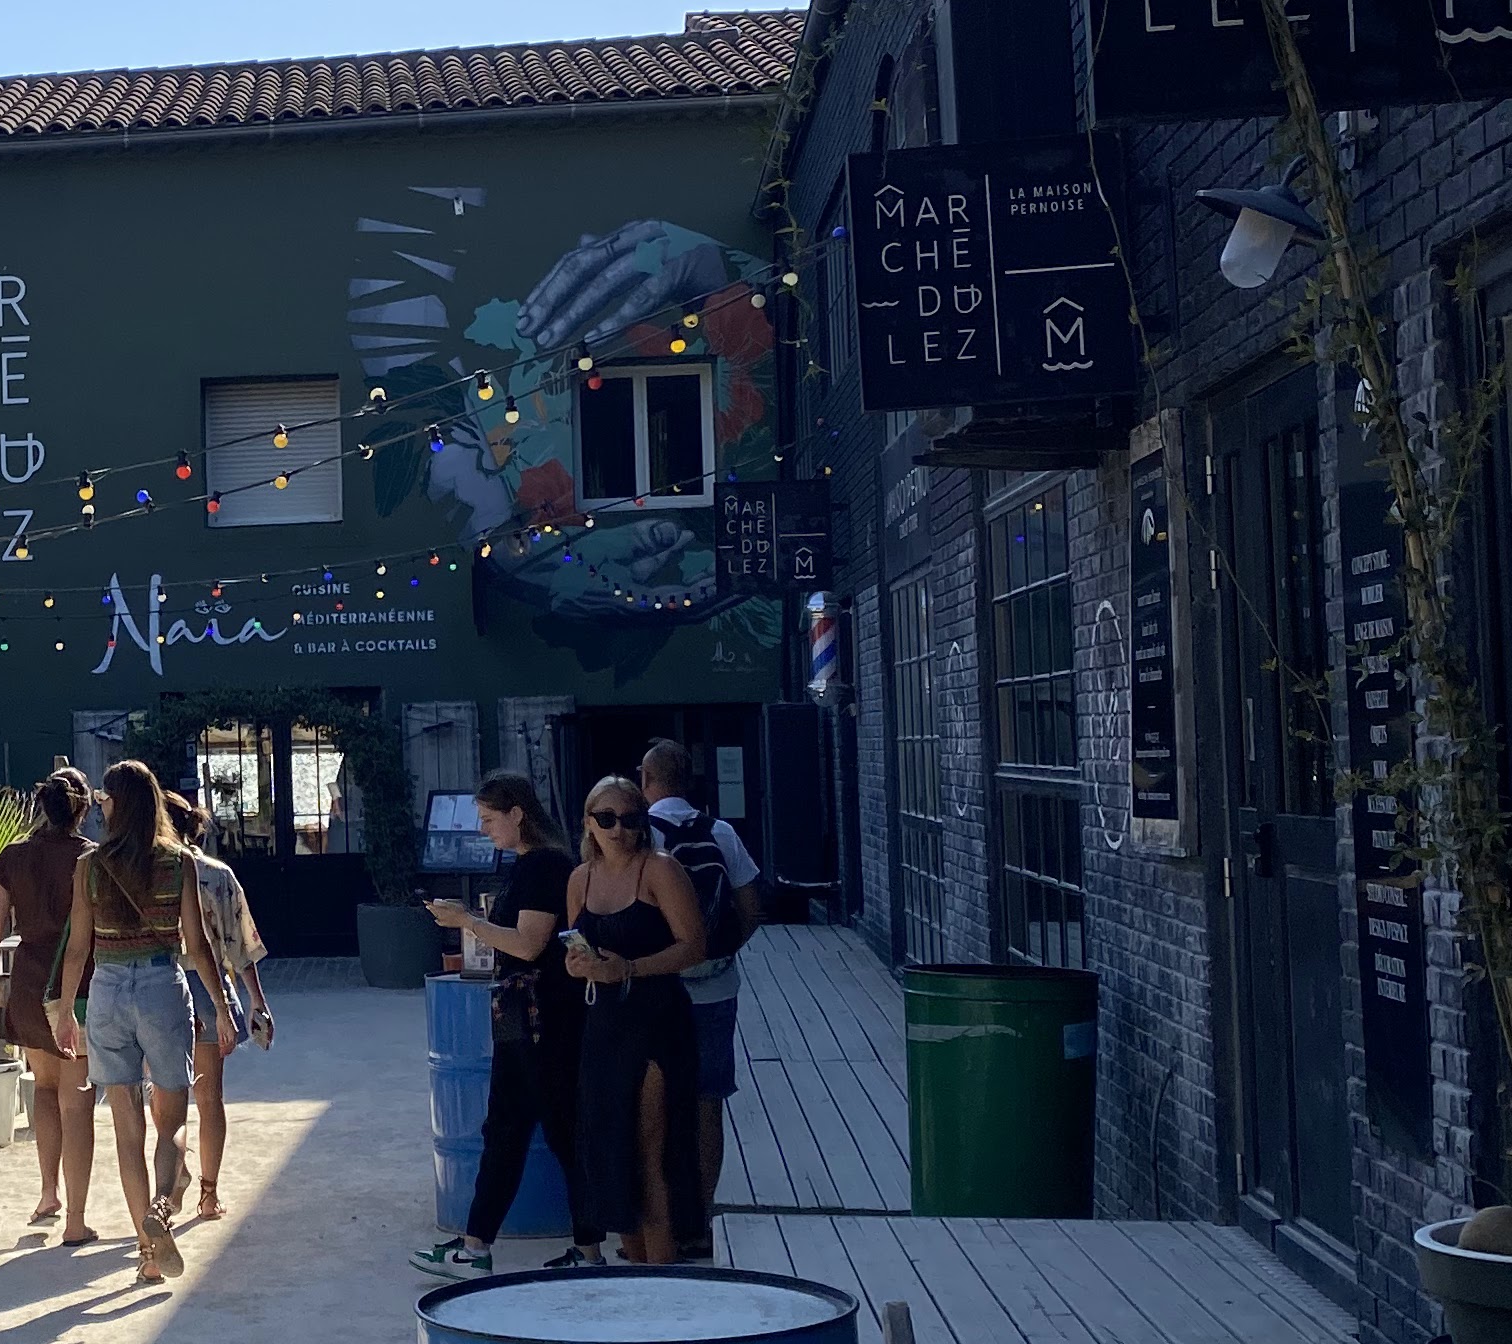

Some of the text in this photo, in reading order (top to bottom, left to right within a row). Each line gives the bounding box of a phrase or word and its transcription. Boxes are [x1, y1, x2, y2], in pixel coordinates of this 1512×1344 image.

[1009, 182, 1092, 200] LA MAISON
[875, 192, 969, 229] MAR
[1010, 199, 1085, 215] PERNOISE
[918, 284, 983, 317] DU
[888, 328, 977, 364] LEZ
[724, 500, 766, 516] MAR
[741, 539, 770, 554] DU
[727, 558, 767, 575] LEZ
[291, 582, 350, 596] CUISINE
[291, 609, 435, 626] MÉDITERRANÉENNE
[293, 636, 437, 654] & BAR À COCKTAILS
